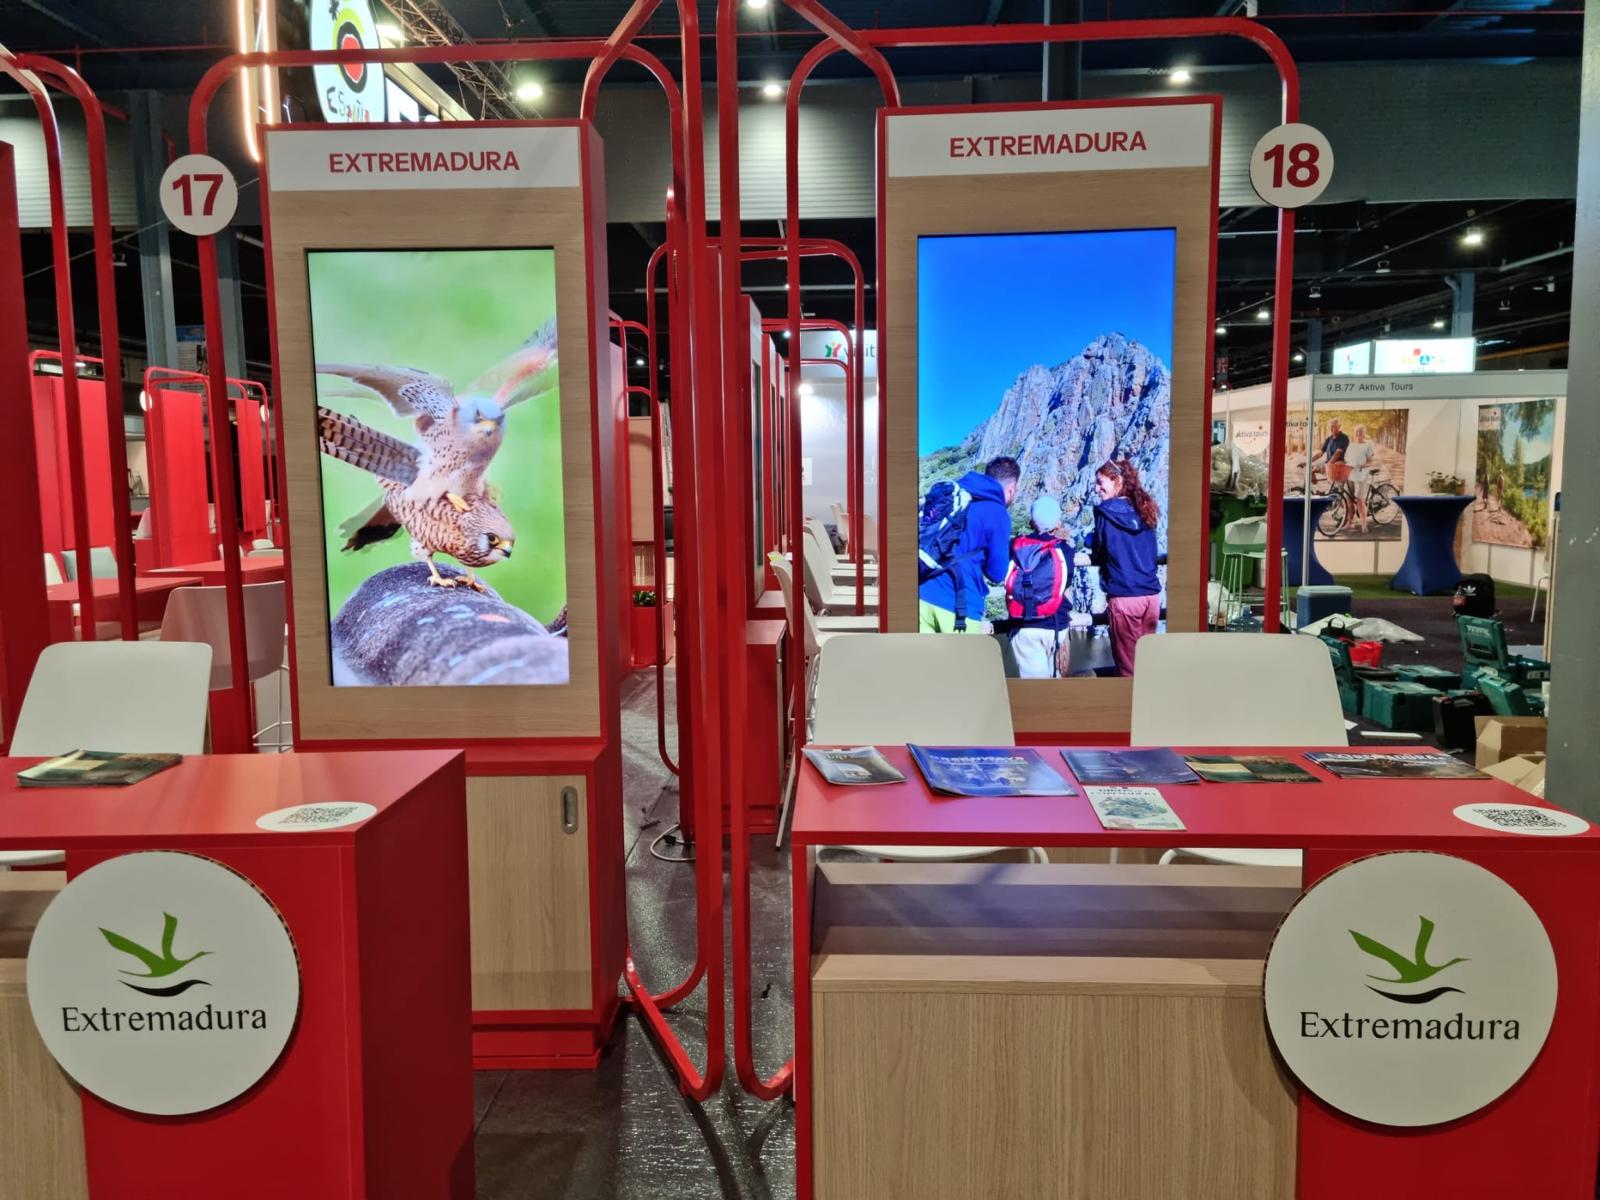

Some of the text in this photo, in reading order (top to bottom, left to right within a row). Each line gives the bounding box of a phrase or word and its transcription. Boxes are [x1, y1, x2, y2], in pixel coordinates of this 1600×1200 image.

[949, 131, 1148, 158] EXTREMADURA
[328, 150, 521, 174] EXTREMADURA
[1263, 143, 1320, 189] 18
[172, 173, 224, 217] 17
[1326, 382, 1414, 392] 9.B.77 Aktiva Tours
[61, 1004, 267, 1032] Extremadura
[1300, 1011, 1520, 1041] Extremadura
